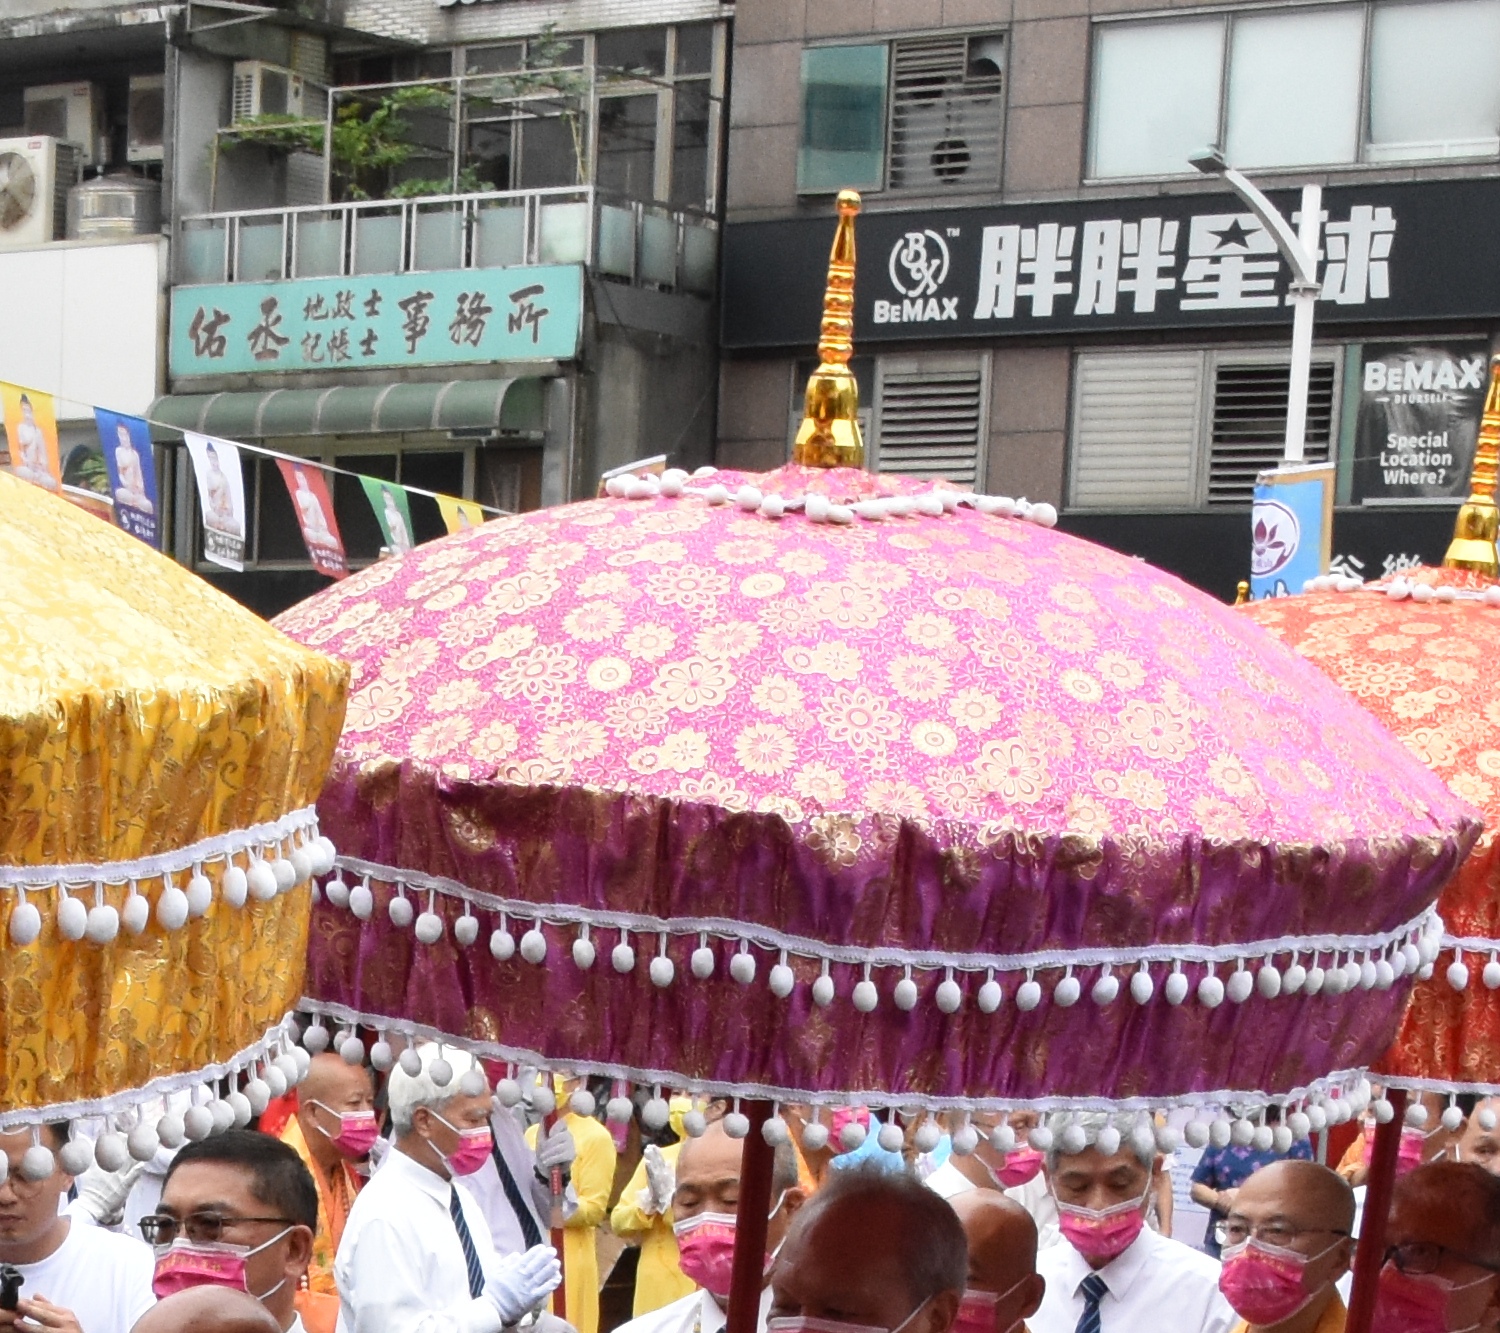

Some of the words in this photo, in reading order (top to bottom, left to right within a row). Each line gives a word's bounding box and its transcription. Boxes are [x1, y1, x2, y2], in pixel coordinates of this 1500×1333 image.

[974, 204, 1396, 318] 胖胖星球
[302, 288, 384, 323] 地政士
[398, 284, 550, 355] 事務所
[188, 296, 290, 362] 佑丞
[301, 328, 379, 364] 記帳士
[1380, 450, 1452, 466] Location
[1387, 431, 1448, 451] Special
[1383, 468, 1446, 485] Where?
